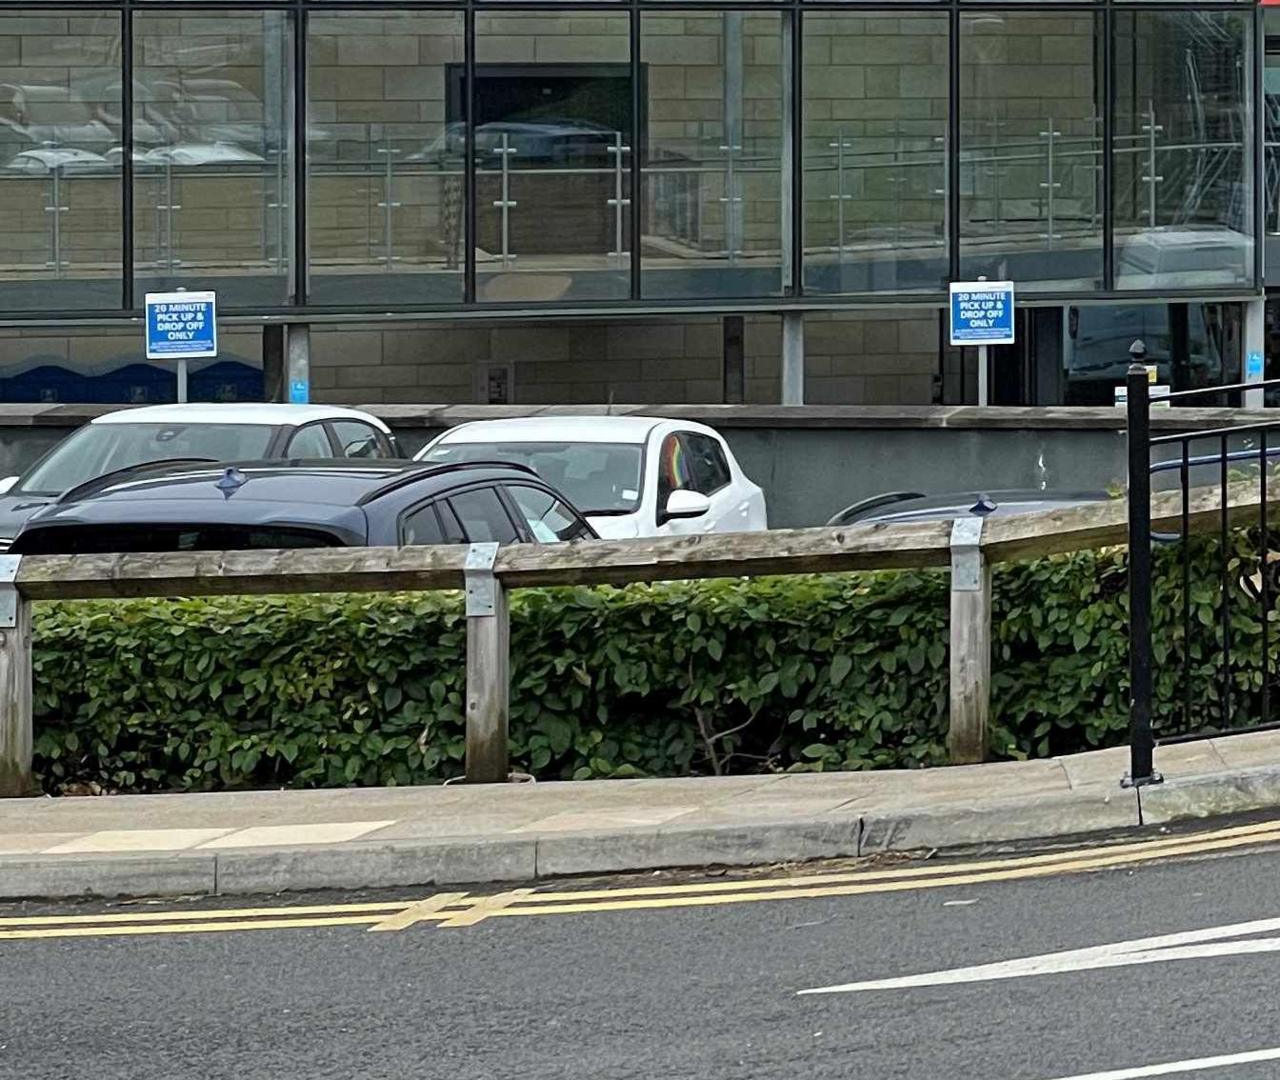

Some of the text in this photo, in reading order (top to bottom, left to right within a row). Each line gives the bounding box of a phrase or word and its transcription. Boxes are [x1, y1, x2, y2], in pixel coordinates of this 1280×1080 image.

[958, 292, 1006, 301] 20 MINUTE
[154, 303, 207, 313] 20 MINUTE
[960, 300, 1004, 310] PICK UP &
[156, 312, 205, 322] PICK UP &
[960, 310, 1004, 319] DROP OFF
[157, 321, 205, 331] DROP OFF
[969, 319, 995, 328] ONLY
[167, 331, 195, 340] ONLY
